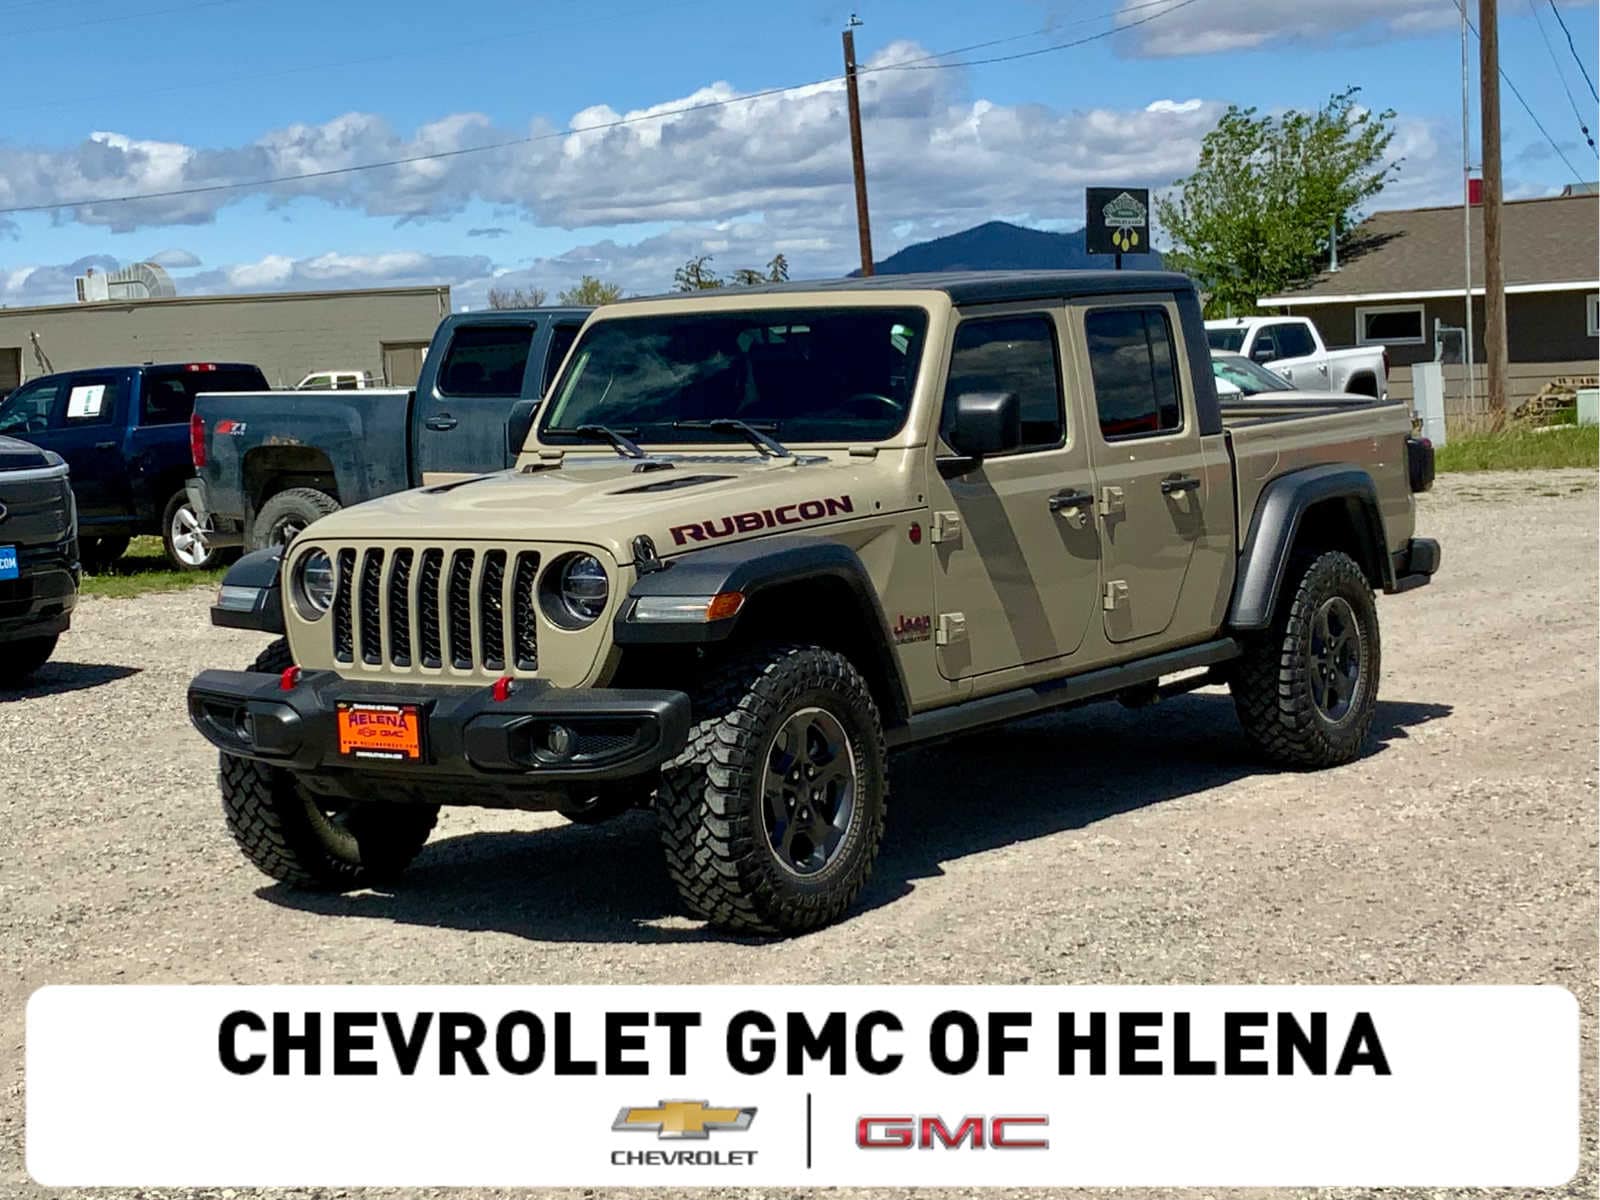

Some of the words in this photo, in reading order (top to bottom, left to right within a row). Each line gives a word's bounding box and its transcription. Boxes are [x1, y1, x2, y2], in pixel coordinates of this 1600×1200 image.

[669, 495, 854, 546] RUBICON
[349, 713, 409, 731] HELENA
[380, 729, 404, 738] GMC
